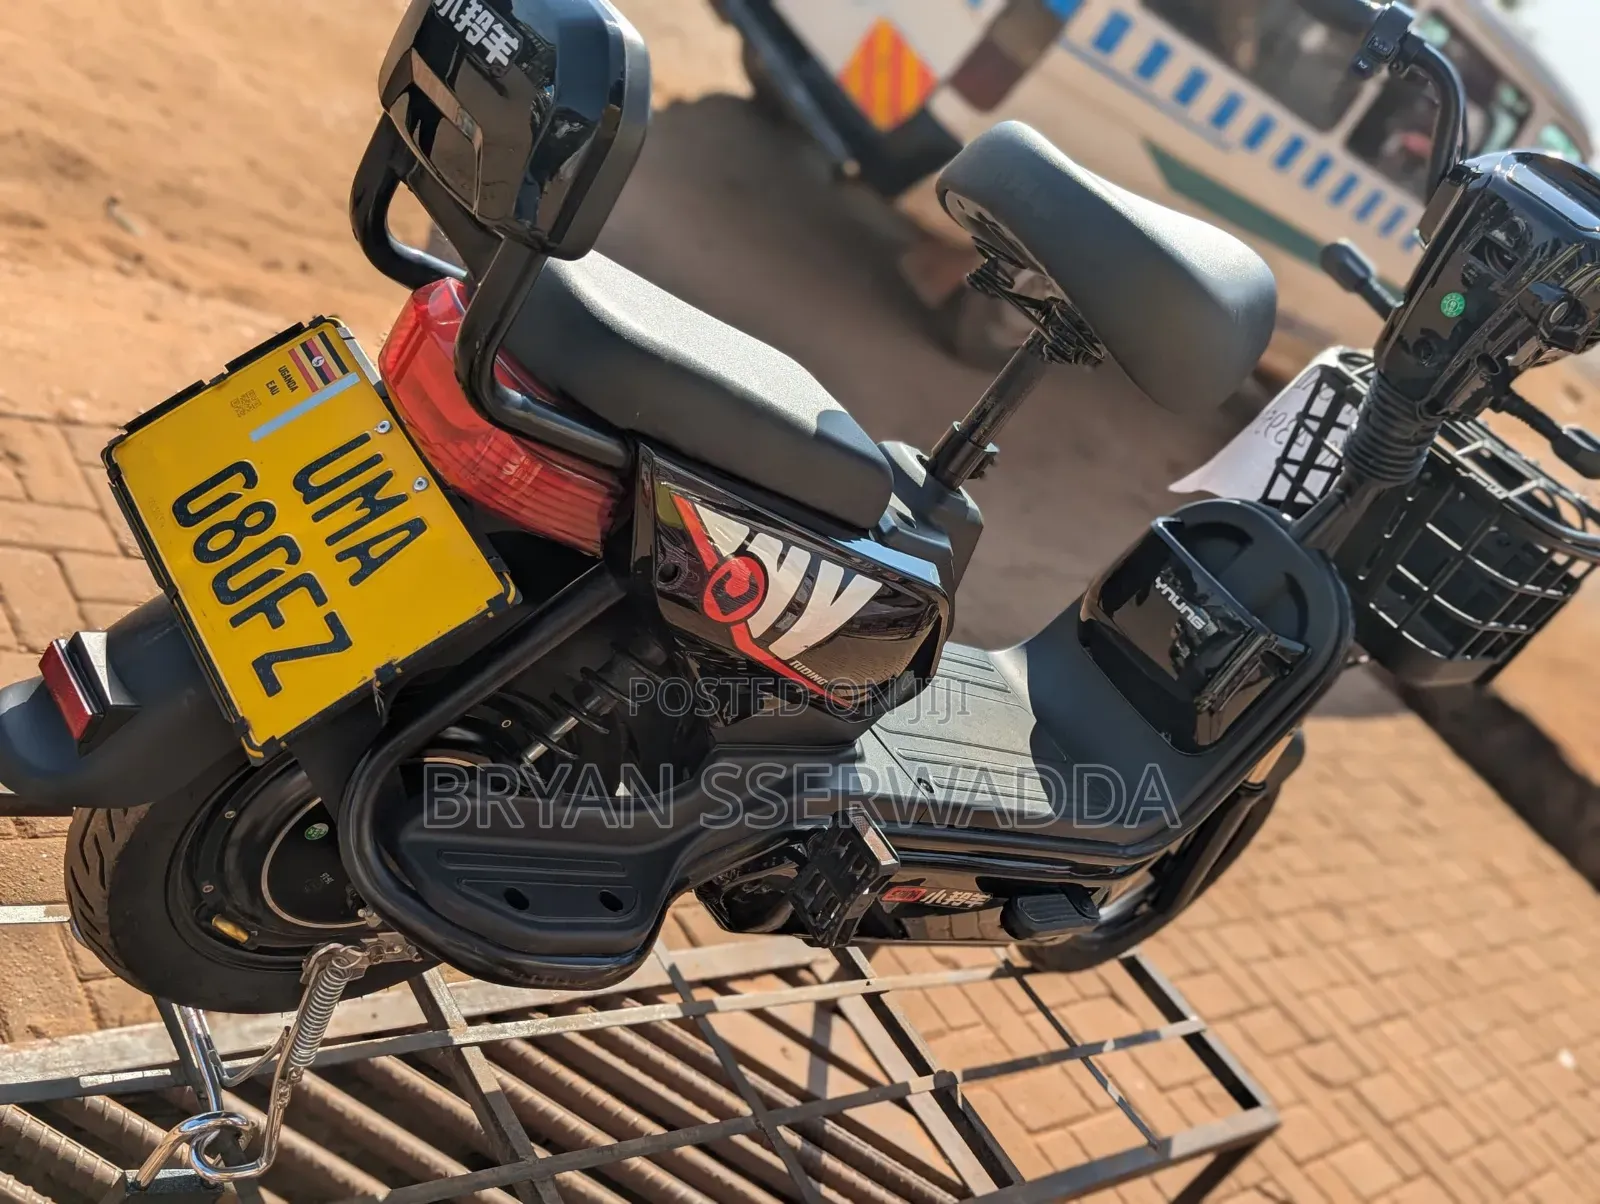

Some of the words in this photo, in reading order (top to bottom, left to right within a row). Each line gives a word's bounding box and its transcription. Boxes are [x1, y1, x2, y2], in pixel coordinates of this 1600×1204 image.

[265, 380, 280, 396] EAU
[278, 365, 299, 393] UGANDA
[292, 431, 428, 587] UMA
